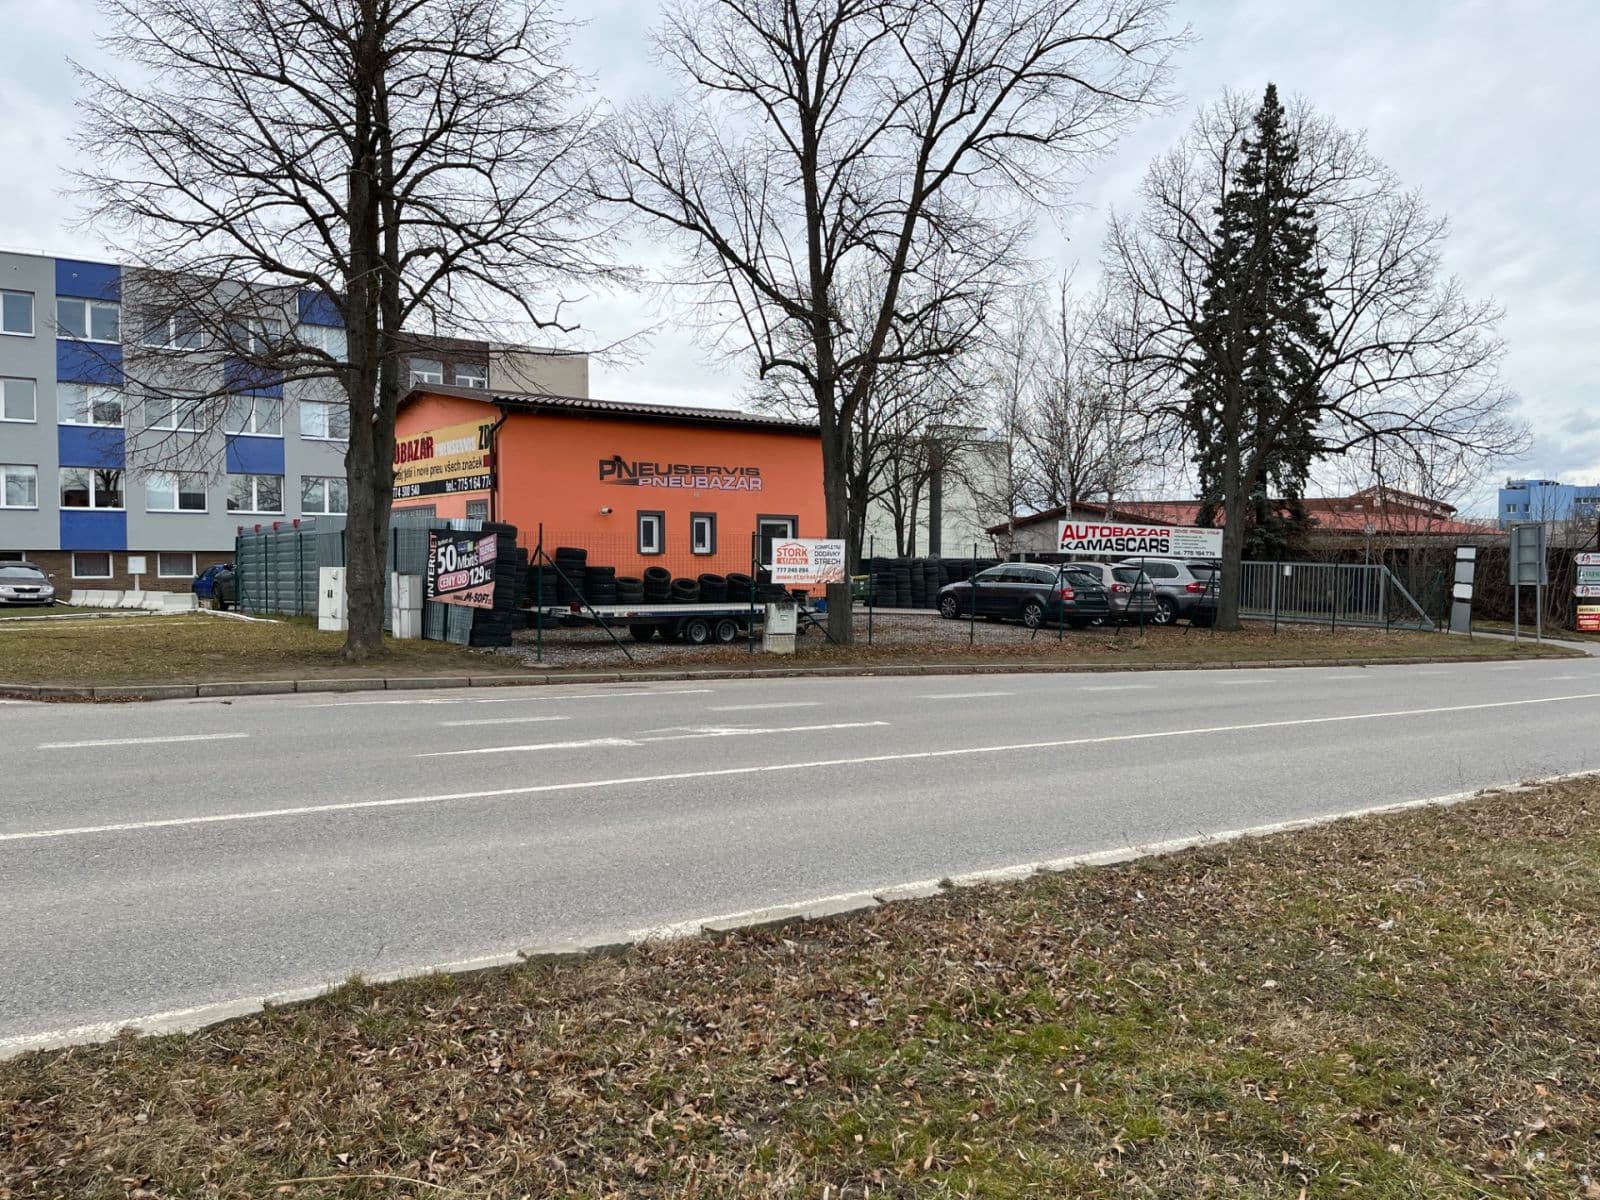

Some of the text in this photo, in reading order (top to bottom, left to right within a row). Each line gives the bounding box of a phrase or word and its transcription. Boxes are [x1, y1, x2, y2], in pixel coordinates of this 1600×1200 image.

[394, 436, 434, 465] UBAZAR
[599, 455, 760, 480] PNEUSERVIS
[638, 476, 762, 491] PNEUBAZAR
[1061, 524, 1170, 541] AUTOBAZAR
[776, 547, 808, 557] STORK
[1060, 537, 1170, 553] KAMASCARS
[427, 531, 437, 598] INTERNET
[437, 544, 457, 574] 50
[456, 573, 467, 585] OD
[469, 565, 485, 585] 129
